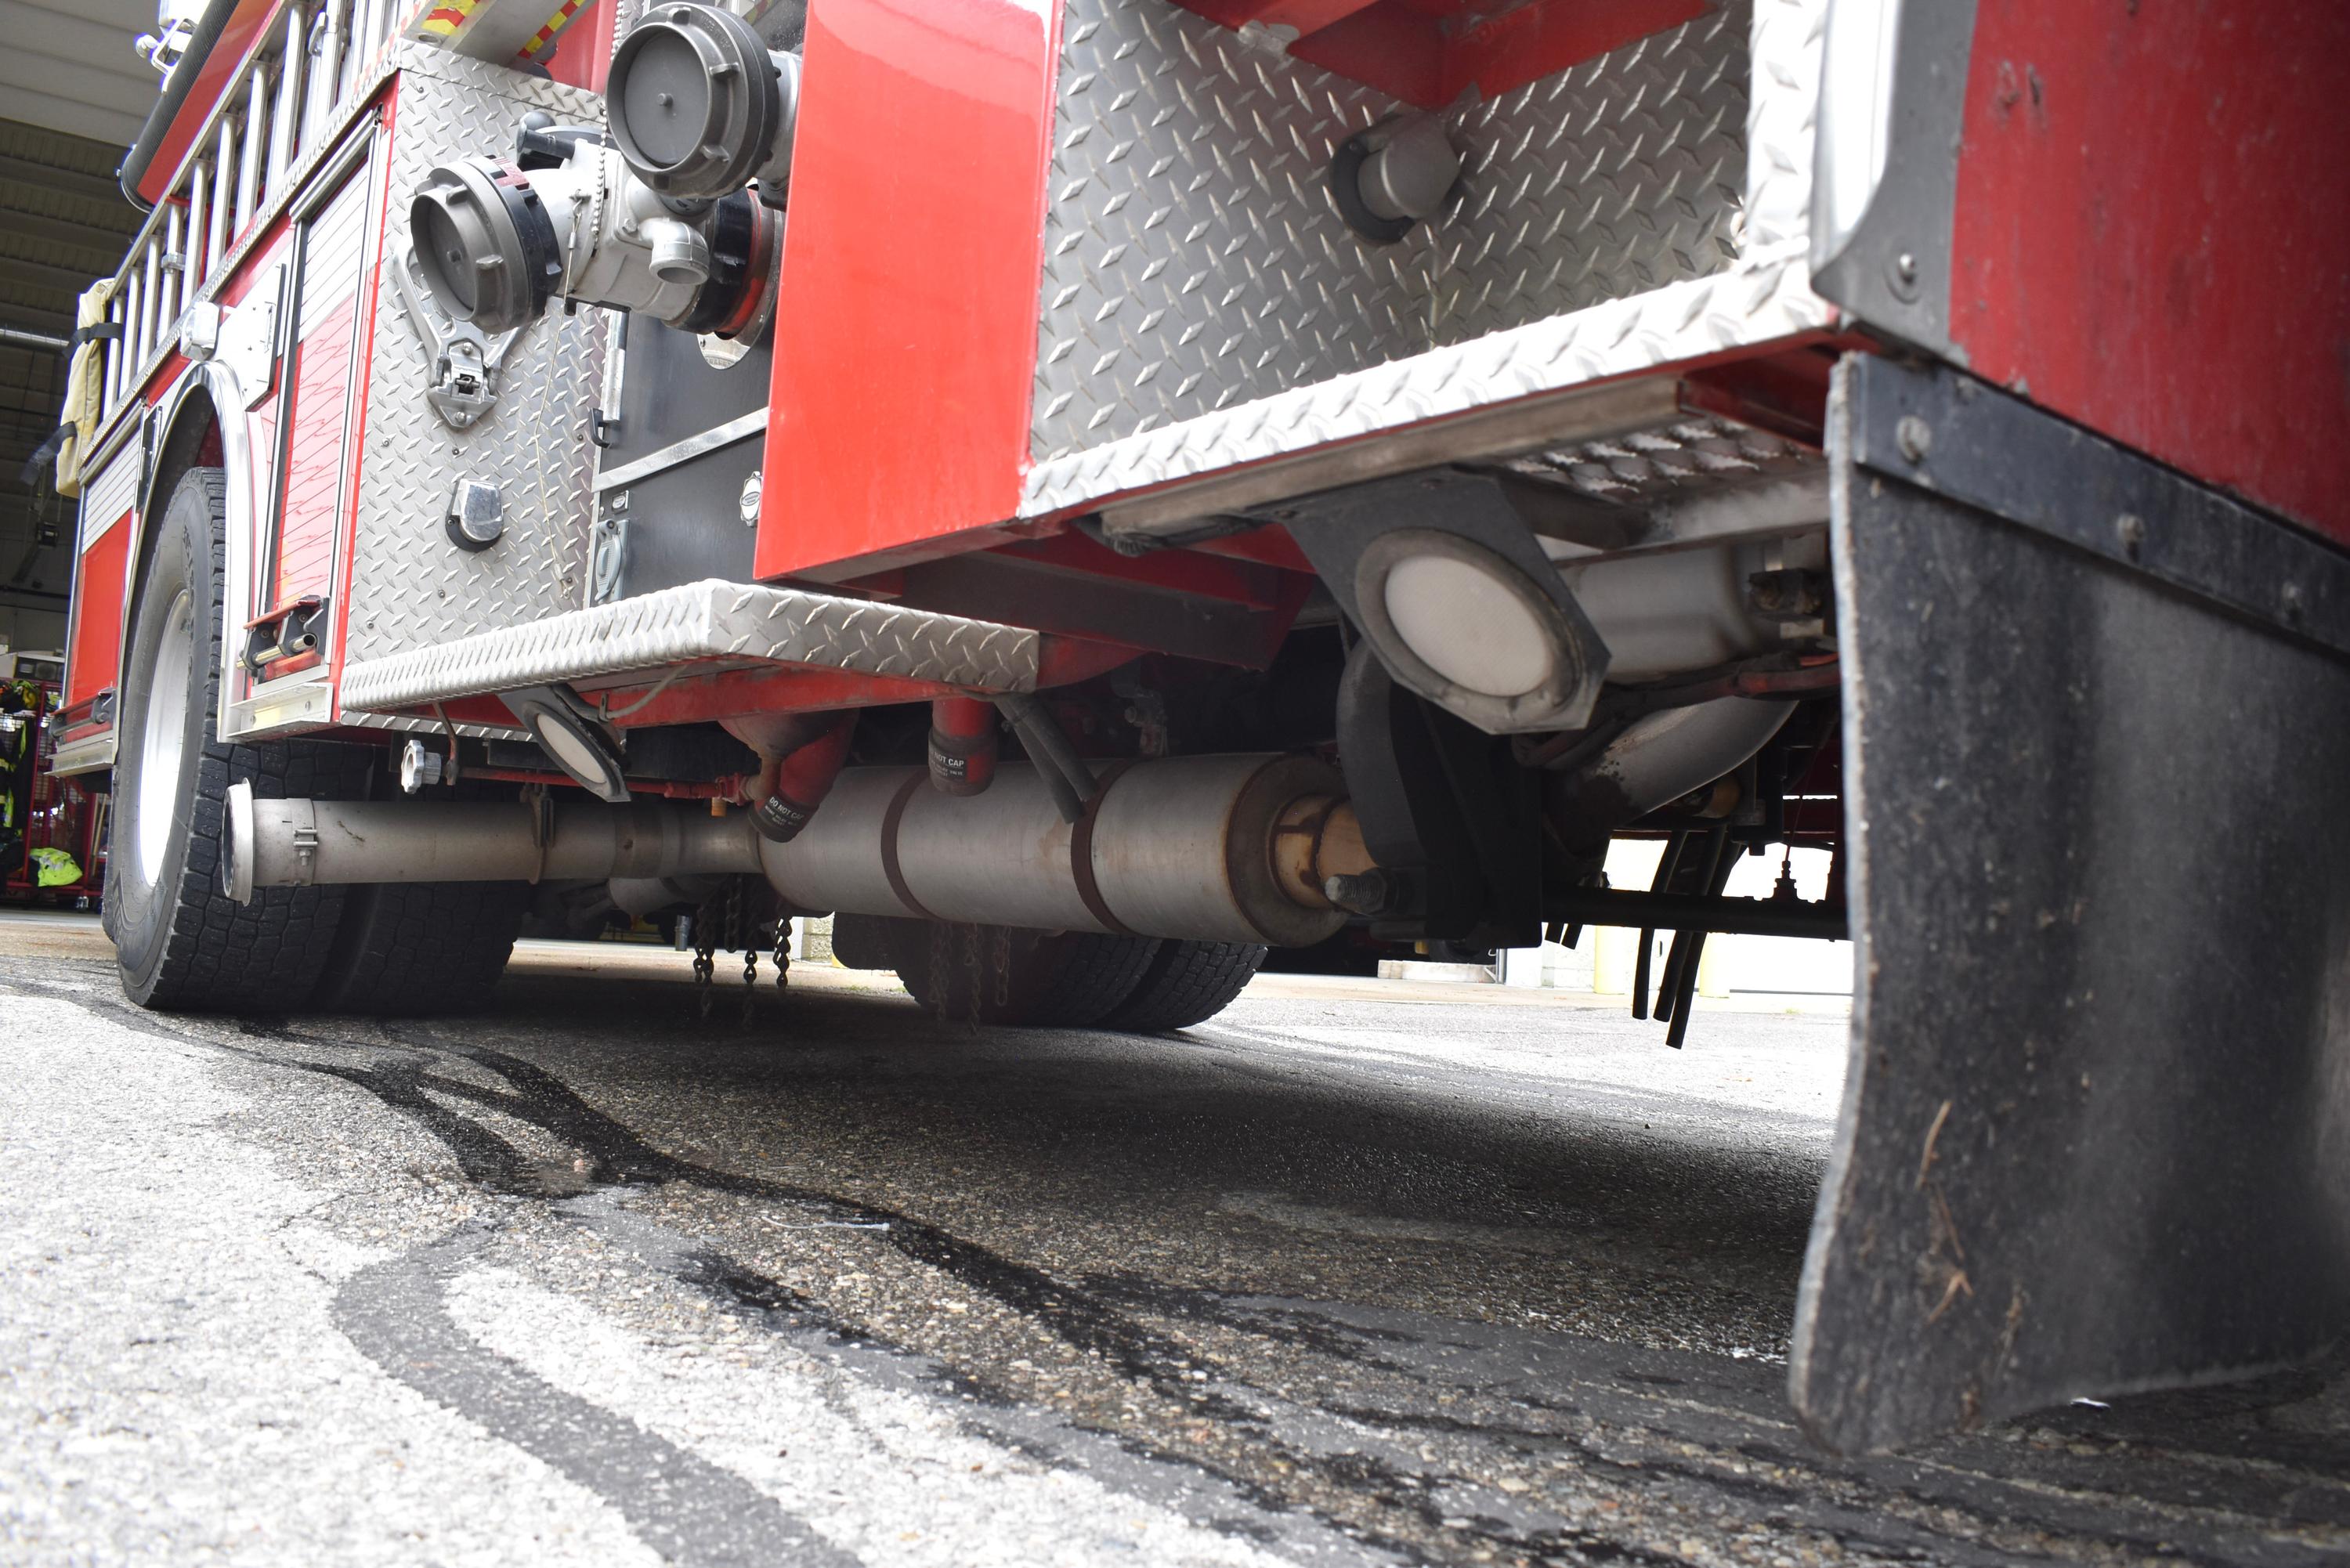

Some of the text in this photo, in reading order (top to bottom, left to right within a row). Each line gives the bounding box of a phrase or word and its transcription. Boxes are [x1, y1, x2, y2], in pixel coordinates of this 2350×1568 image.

[934, 752, 964, 767] NOT CAP
[769, 797, 779, 807] DO
[778, 804, 791, 815] NOT
